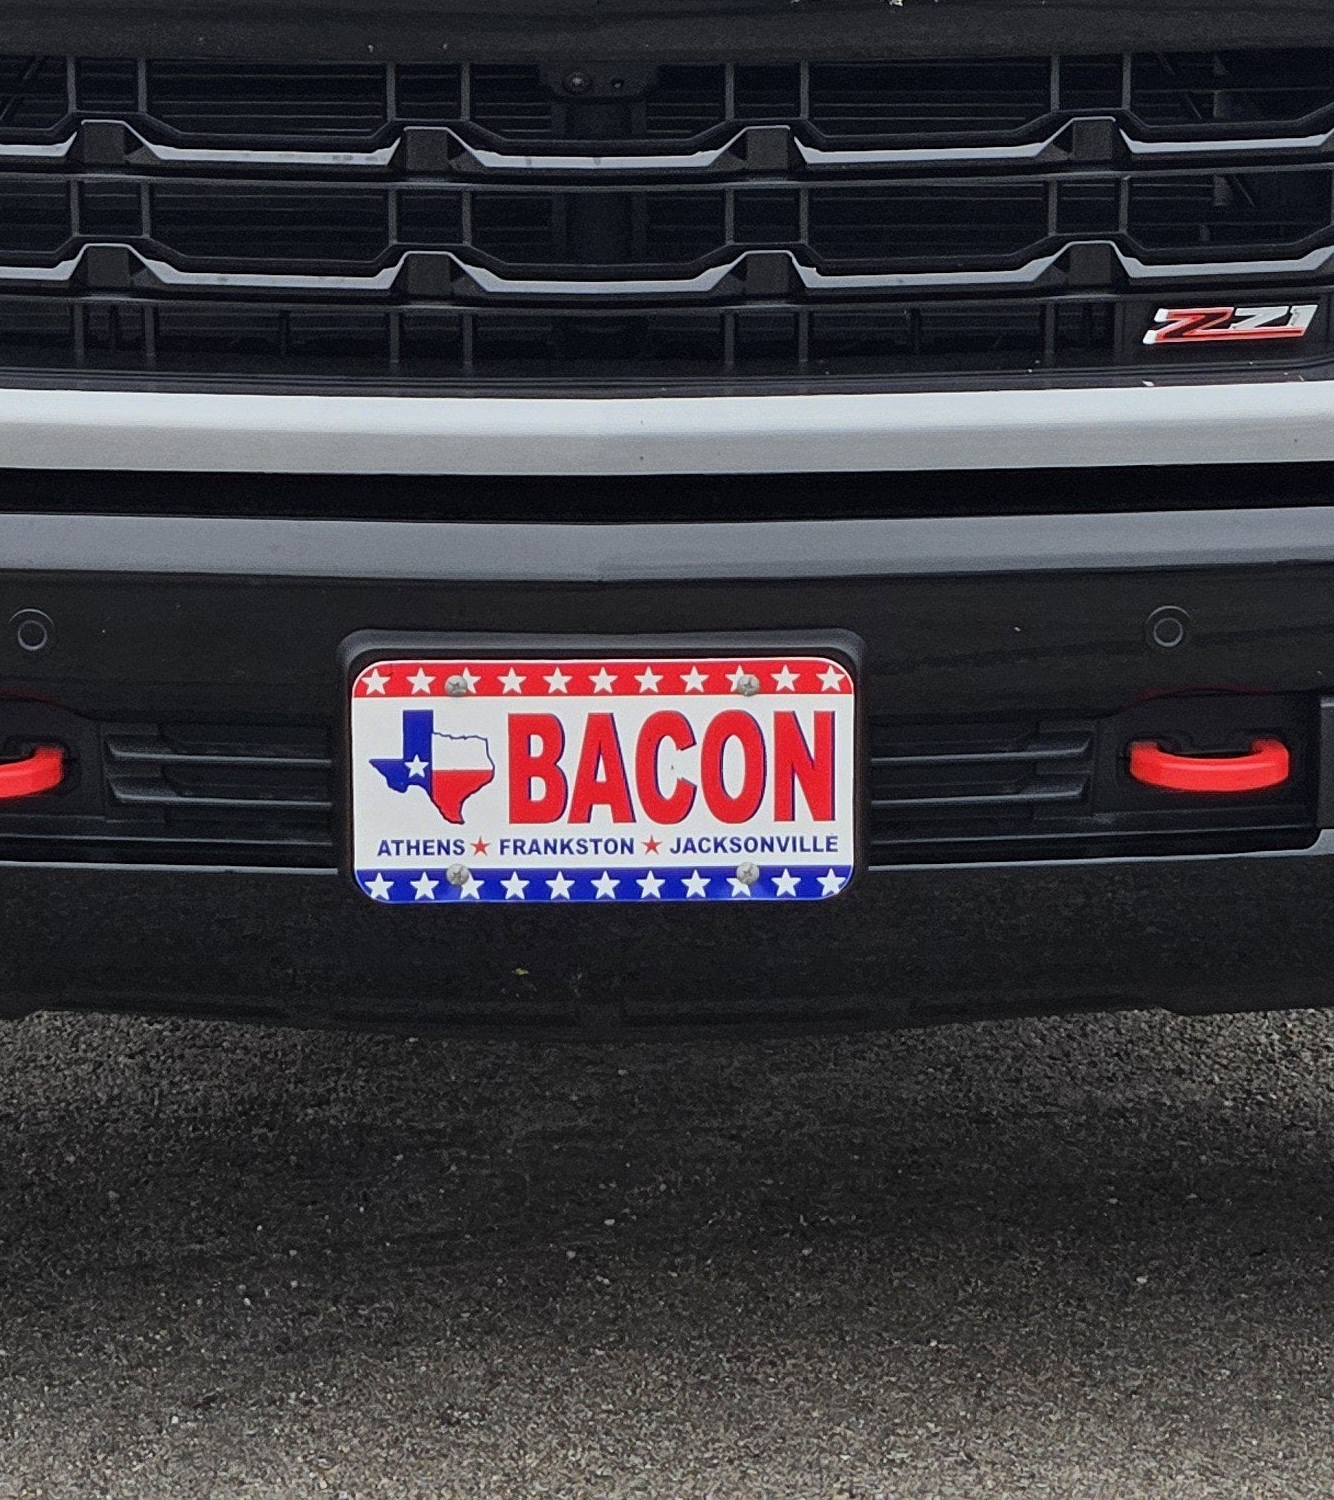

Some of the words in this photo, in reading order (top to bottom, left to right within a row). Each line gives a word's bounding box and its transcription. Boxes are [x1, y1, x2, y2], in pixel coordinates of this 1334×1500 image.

[1142, 304, 1319, 344] Z71
[507, 708, 837, 825] BACON
[376, 838, 466, 857] ATHENS
[498, 837, 636, 856] FRANKSTON
[669, 834, 840, 855] JACKSONVILLE
